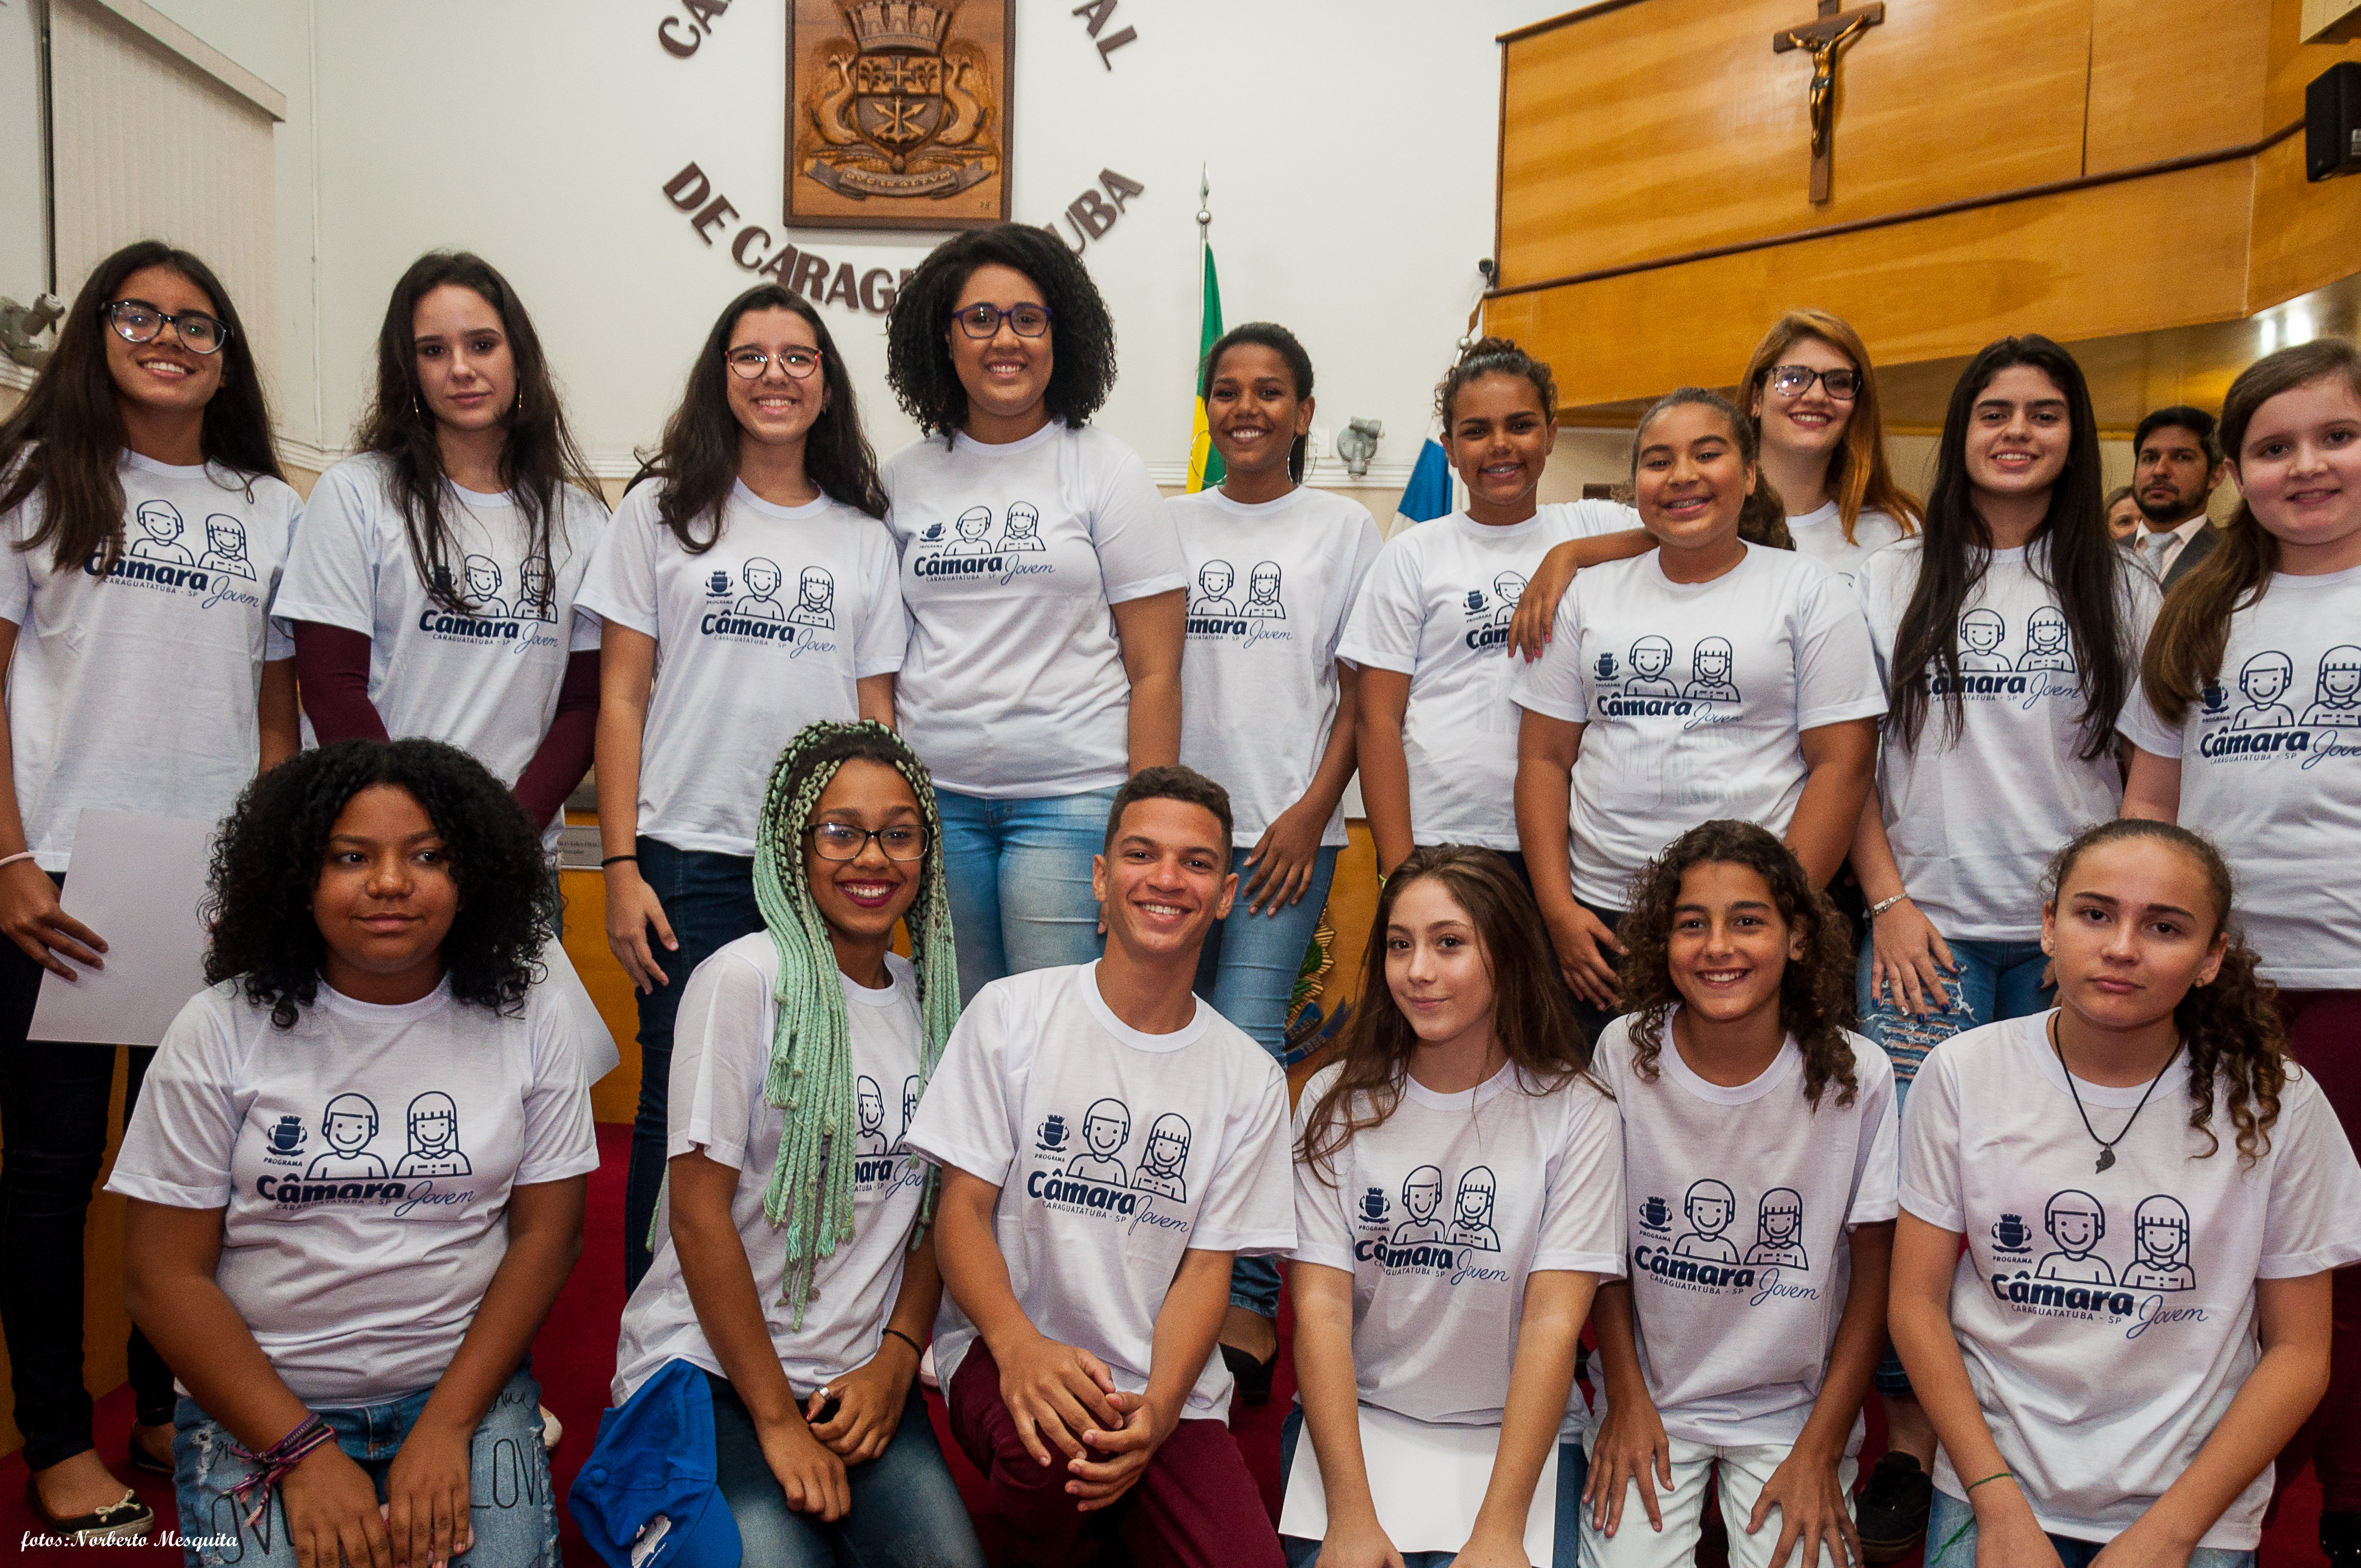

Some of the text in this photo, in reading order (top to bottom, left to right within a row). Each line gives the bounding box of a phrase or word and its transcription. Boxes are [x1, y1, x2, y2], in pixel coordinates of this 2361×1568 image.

[662, 161, 740, 246] DE
[914, 552, 1055, 586] Câmara Jovem
[188, 589, 198, 597] SP
[202, 575, 259, 609] Jovem
[419, 608, 558, 654] Câmara Jovem
[433, 634, 493, 645] CARAGUATATUBA
[701, 608, 796, 643] Câmara
[1185, 618, 1292, 649] mara Jovem
[1466, 622, 1510, 650] Câm
[1597, 692, 1693, 716] Câmara
[2200, 726, 2310, 758] Câmara
[2210, 753, 2271, 765] CARAGUATATUBA
[264, 1157, 302, 1167] PROGRAMA
[1035, 1153, 1065, 1162] PROGRAMA
[855, 1158, 925, 1200] ara Jov
[256, 1173, 476, 1217] Câmara Jovem
[1027, 1168, 1189, 1235] Câmara Jovem
[1042, 1201, 1106, 1218] CARAGUATATUBA
[1639, 1231, 1671, 1242] PROGRAMA
[1355, 1235, 1510, 1285] Câmara Jovem
[1993, 1255, 2033, 1264] PROGRAMA
[1634, 1245, 1820, 1306] Câmara Jovem
[1650, 1274, 1721, 1295] CARAGUATATUBA
[1991, 1270, 2208, 1338] Câmara Jovem
[2011, 1304, 2121, 1324] CARAGUATATUBA SP
